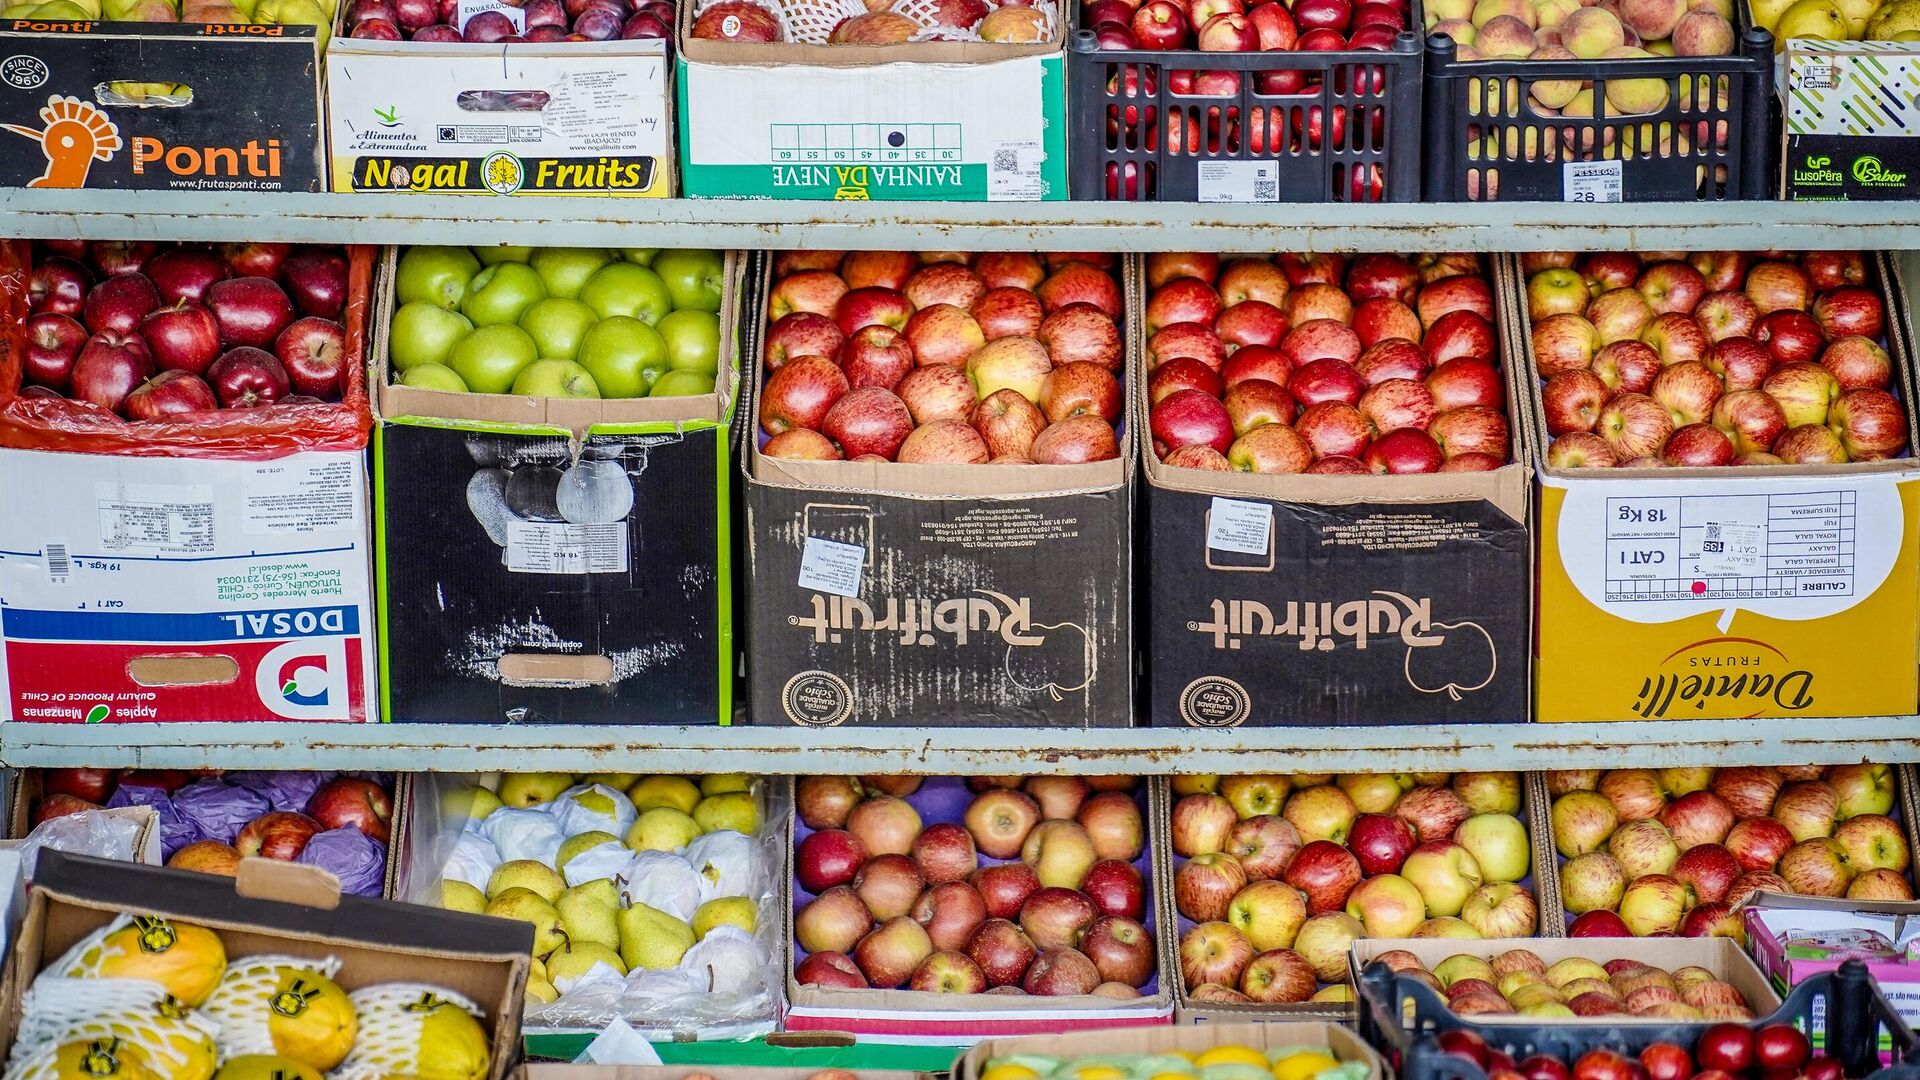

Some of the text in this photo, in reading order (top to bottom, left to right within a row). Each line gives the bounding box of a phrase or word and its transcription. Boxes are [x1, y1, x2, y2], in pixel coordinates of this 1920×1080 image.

[12, 19, 92, 33] Ponti
[203, 24, 285, 37] Ponti
[7, 58, 42, 72] SINCE
[10, 73, 41, 86] 1960
[356, 130, 418, 141] Alimentos
[613, 130, 637, 138] BENITO
[358, 141, 429, 151] Extremadura
[131, 136, 282, 177] Ponti
[133, 136, 144, 173] Frutas
[780, 151, 954, 159] 30 35 40 45 50 55 60
[364, 157, 642, 192] Nogal Fruits
[772, 165, 962, 187] RAINHA DA NEVE
[1572, 168, 1614, 178] PESSEGO
[1793, 169, 1843, 182] LusoPêra
[1864, 167, 1907, 182] Sabor
[169, 178, 282, 191] www.frutasponti.com
[1219, 193, 1233, 201] 9kg
[1573, 192, 1595, 202] 28
[1618, 505, 1667, 523] 18 Kg
[1791, 506, 1838, 516] FUJI SUPREMA
[1823, 519, 1837, 527] FUJI
[1795, 533, 1814, 541] GALA
[960, 541, 976, 549] LTDA.
[976, 541, 994, 549] SCHIO
[1377, 542, 1395, 550] SCHIO
[1736, 546, 1758, 555] CAT
[553, 551, 566, 559] KG
[1620, 550, 1666, 565] CAT I
[1725, 556, 1757, 564] GALAXY
[1804, 557, 1836, 565] IMPERIAL
[87, 561, 121, 571] 19 kgs.
[248, 563, 309, 575] www.dosal.cl
[216, 569, 341, 585] FonoFax: (56-75) 2310034
[217, 578, 342, 594] TUTUQUÉN, Curicó CHILE
[1801, 582, 1846, 592] CALIBRE
[218, 587, 342, 603] Huerto Mercedes Carolina
[97, 600, 124, 608] CAT 1
[225, 610, 344, 636] DOSAL
[798, 589, 1046, 647] Rubifruit
[1198, 590, 1446, 652] Rubifruit
[1690, 656, 1761, 667] FRUTAS
[50, 692, 66, 701] OF
[804, 687, 834, 700] Schio
[1203, 693, 1232, 705] Schio
[1631, 670, 1814, 719] Danielli
[798, 695, 836, 707] QUALIDADE
[1196, 701, 1234, 712] QUALIDADE
[22, 704, 158, 720] Apples Manzanas
